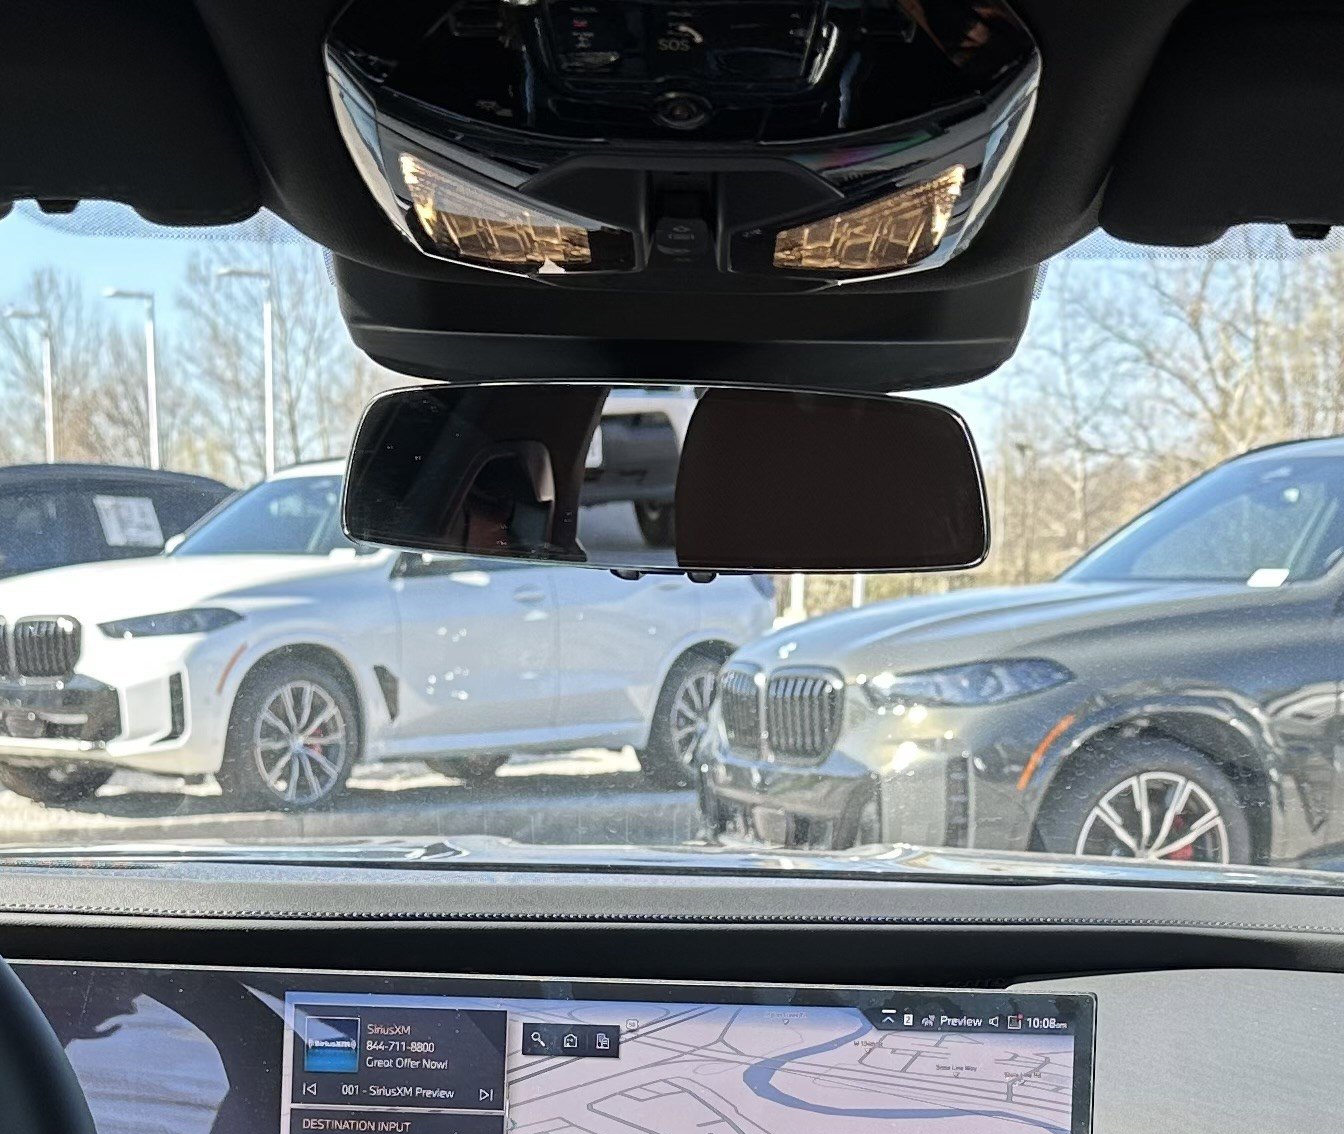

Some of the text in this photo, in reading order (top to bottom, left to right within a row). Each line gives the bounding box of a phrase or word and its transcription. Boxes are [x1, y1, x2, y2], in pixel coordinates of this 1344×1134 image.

[658, 39, 690, 51] SOS
[940, 1016, 983, 1028] Preview
[367, 1024, 411, 1036] SiriusXM
[366, 1041, 435, 1053] 844-711-8800
[366, 1056, 449, 1070] Great Offer Now!
[341, 1084, 359, 1096] 001
[369, 1085, 413, 1097] SiriusXM
[415, 1086, 455, 1099] Preview
[302, 1118, 412, 1133] DESTINATION INPUT
